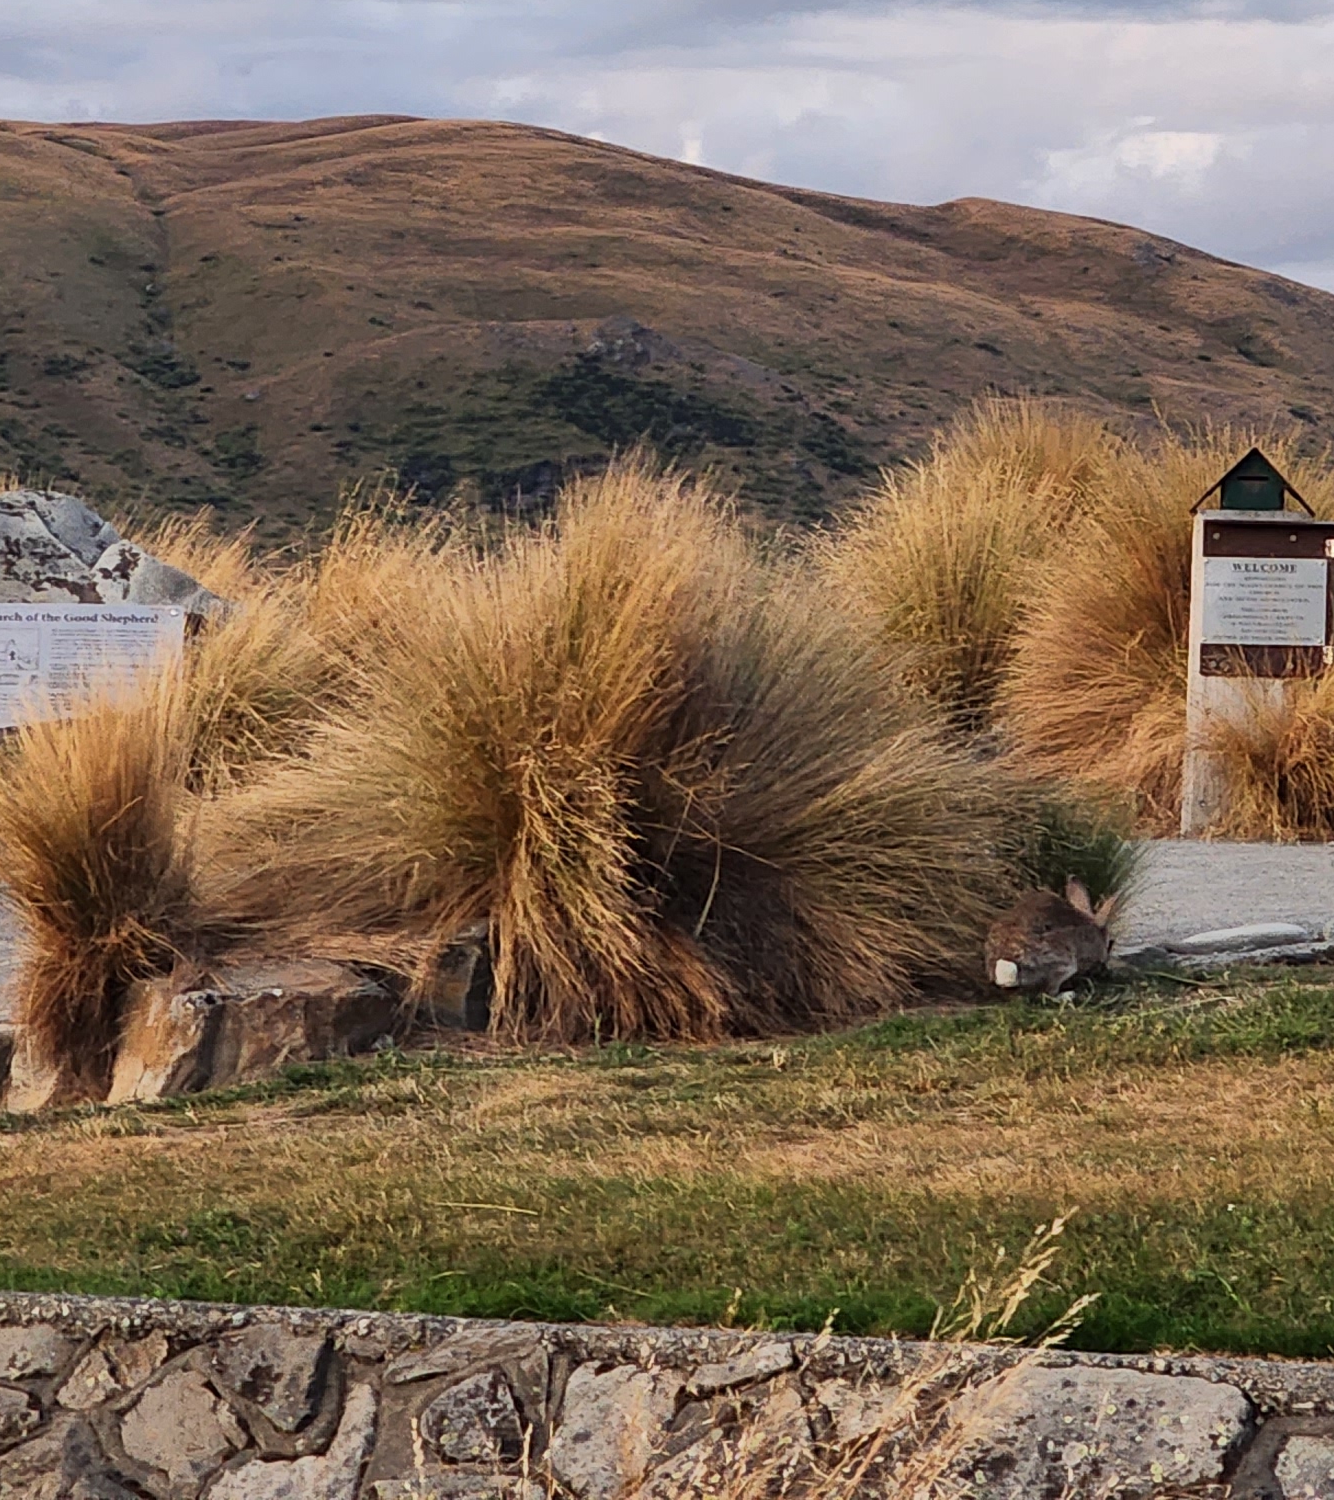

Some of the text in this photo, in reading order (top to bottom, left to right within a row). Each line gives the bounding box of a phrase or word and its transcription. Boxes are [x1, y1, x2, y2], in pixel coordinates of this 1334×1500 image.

[1232, 563, 1297, 573] WELCOME
[25, 612, 39, 621] of
[42, 612, 61, 622] the
[64, 613, 98, 622] Good
[101, 613, 159, 625] Shepherd
